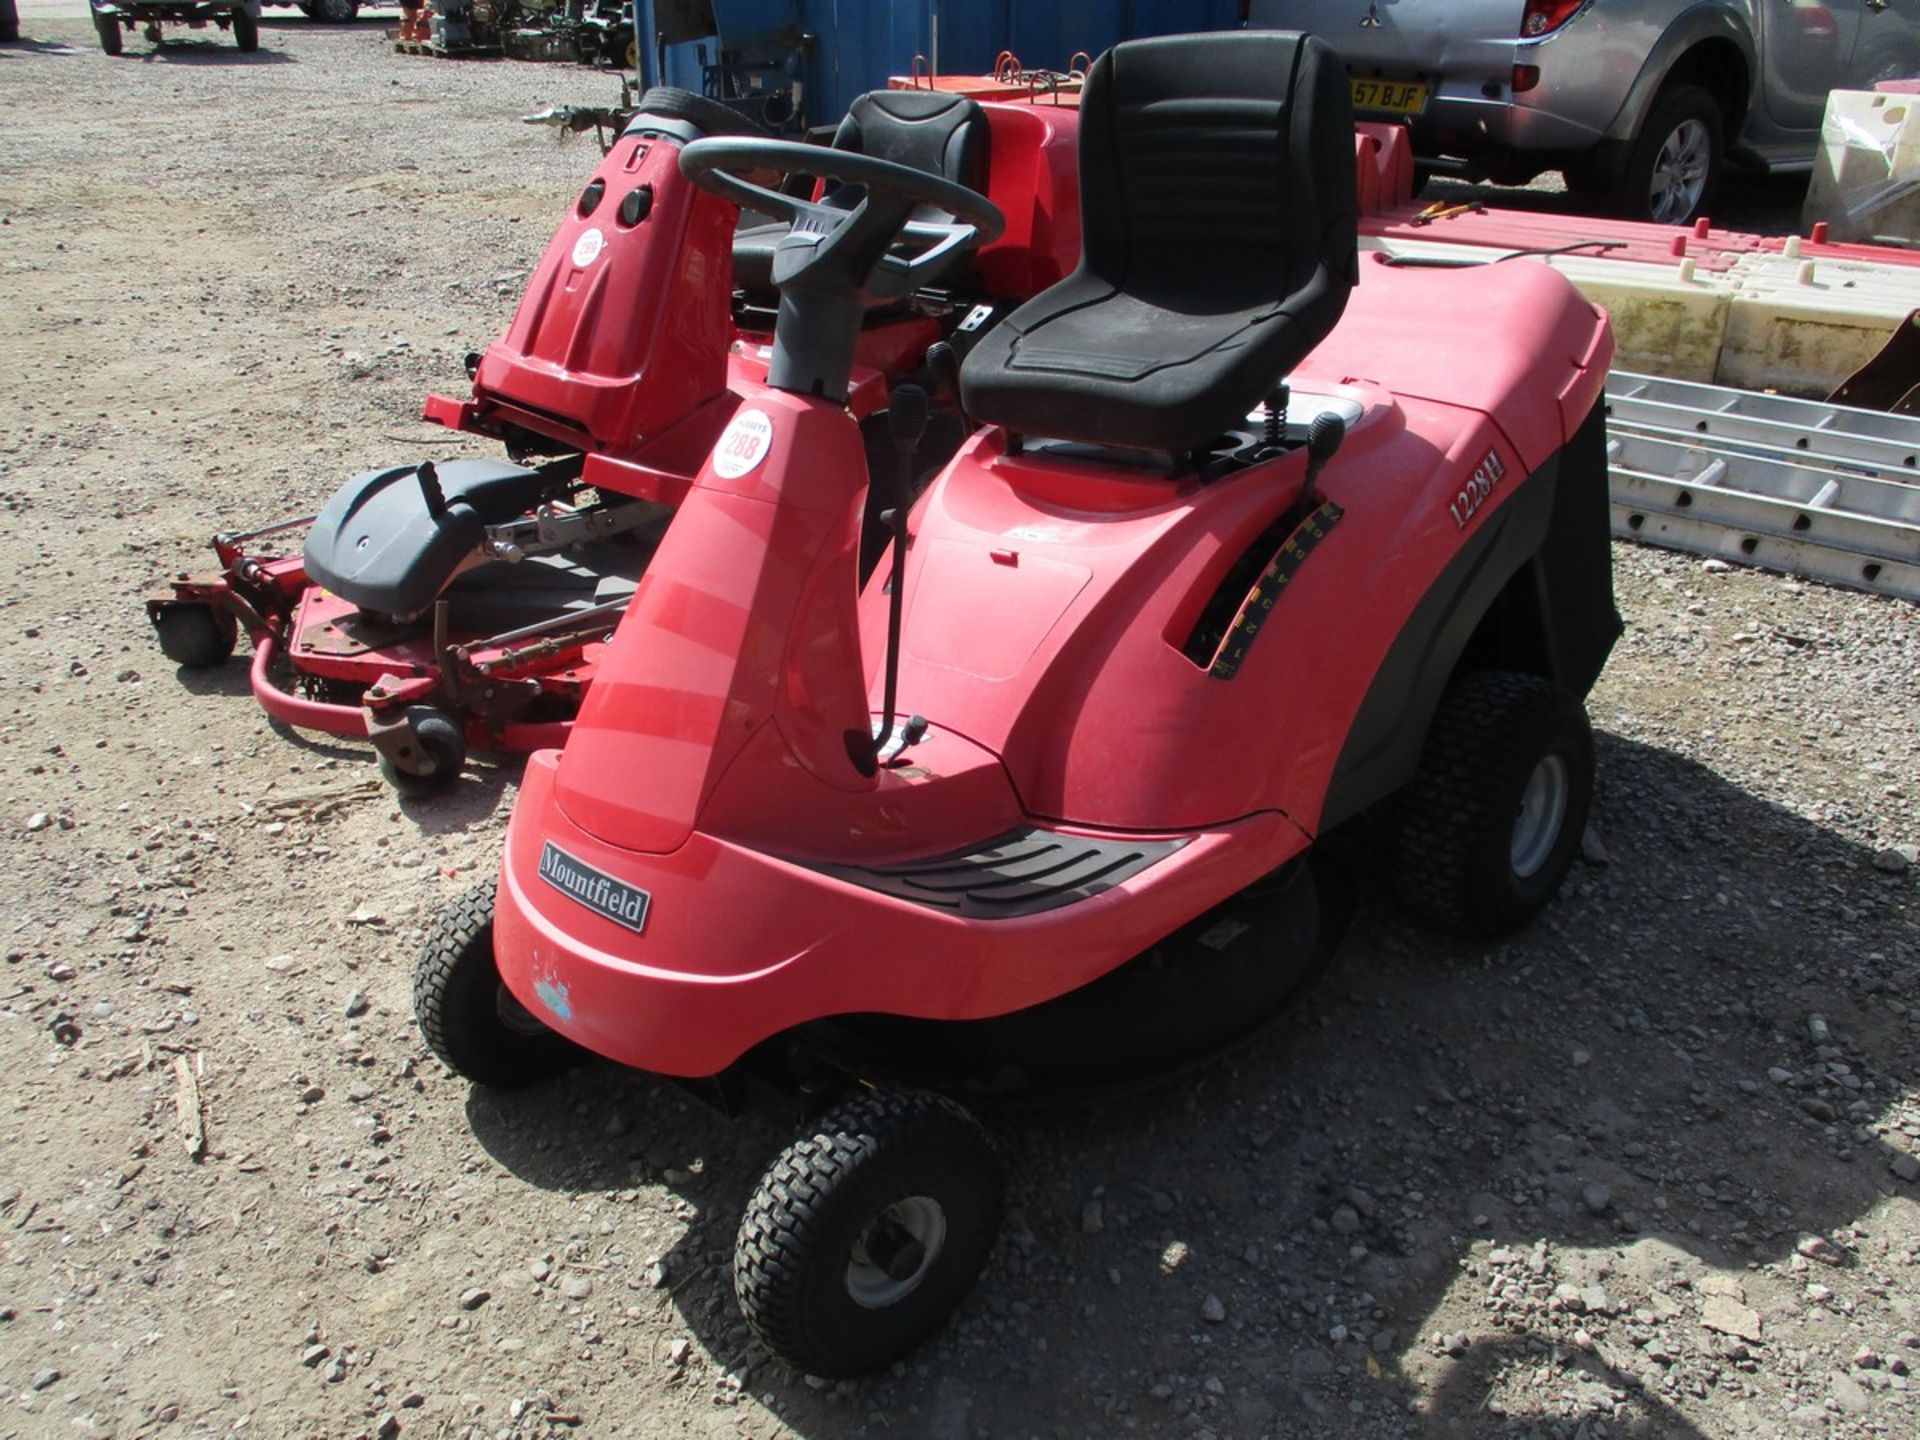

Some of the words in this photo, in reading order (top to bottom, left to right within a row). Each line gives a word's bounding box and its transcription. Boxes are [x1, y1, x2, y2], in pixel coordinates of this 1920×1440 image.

[1380, 85, 1418, 108] BJF
[724, 431, 761, 460] 288
[1449, 449, 1504, 529] 1228H
[541, 846, 643, 922] Mountfield
